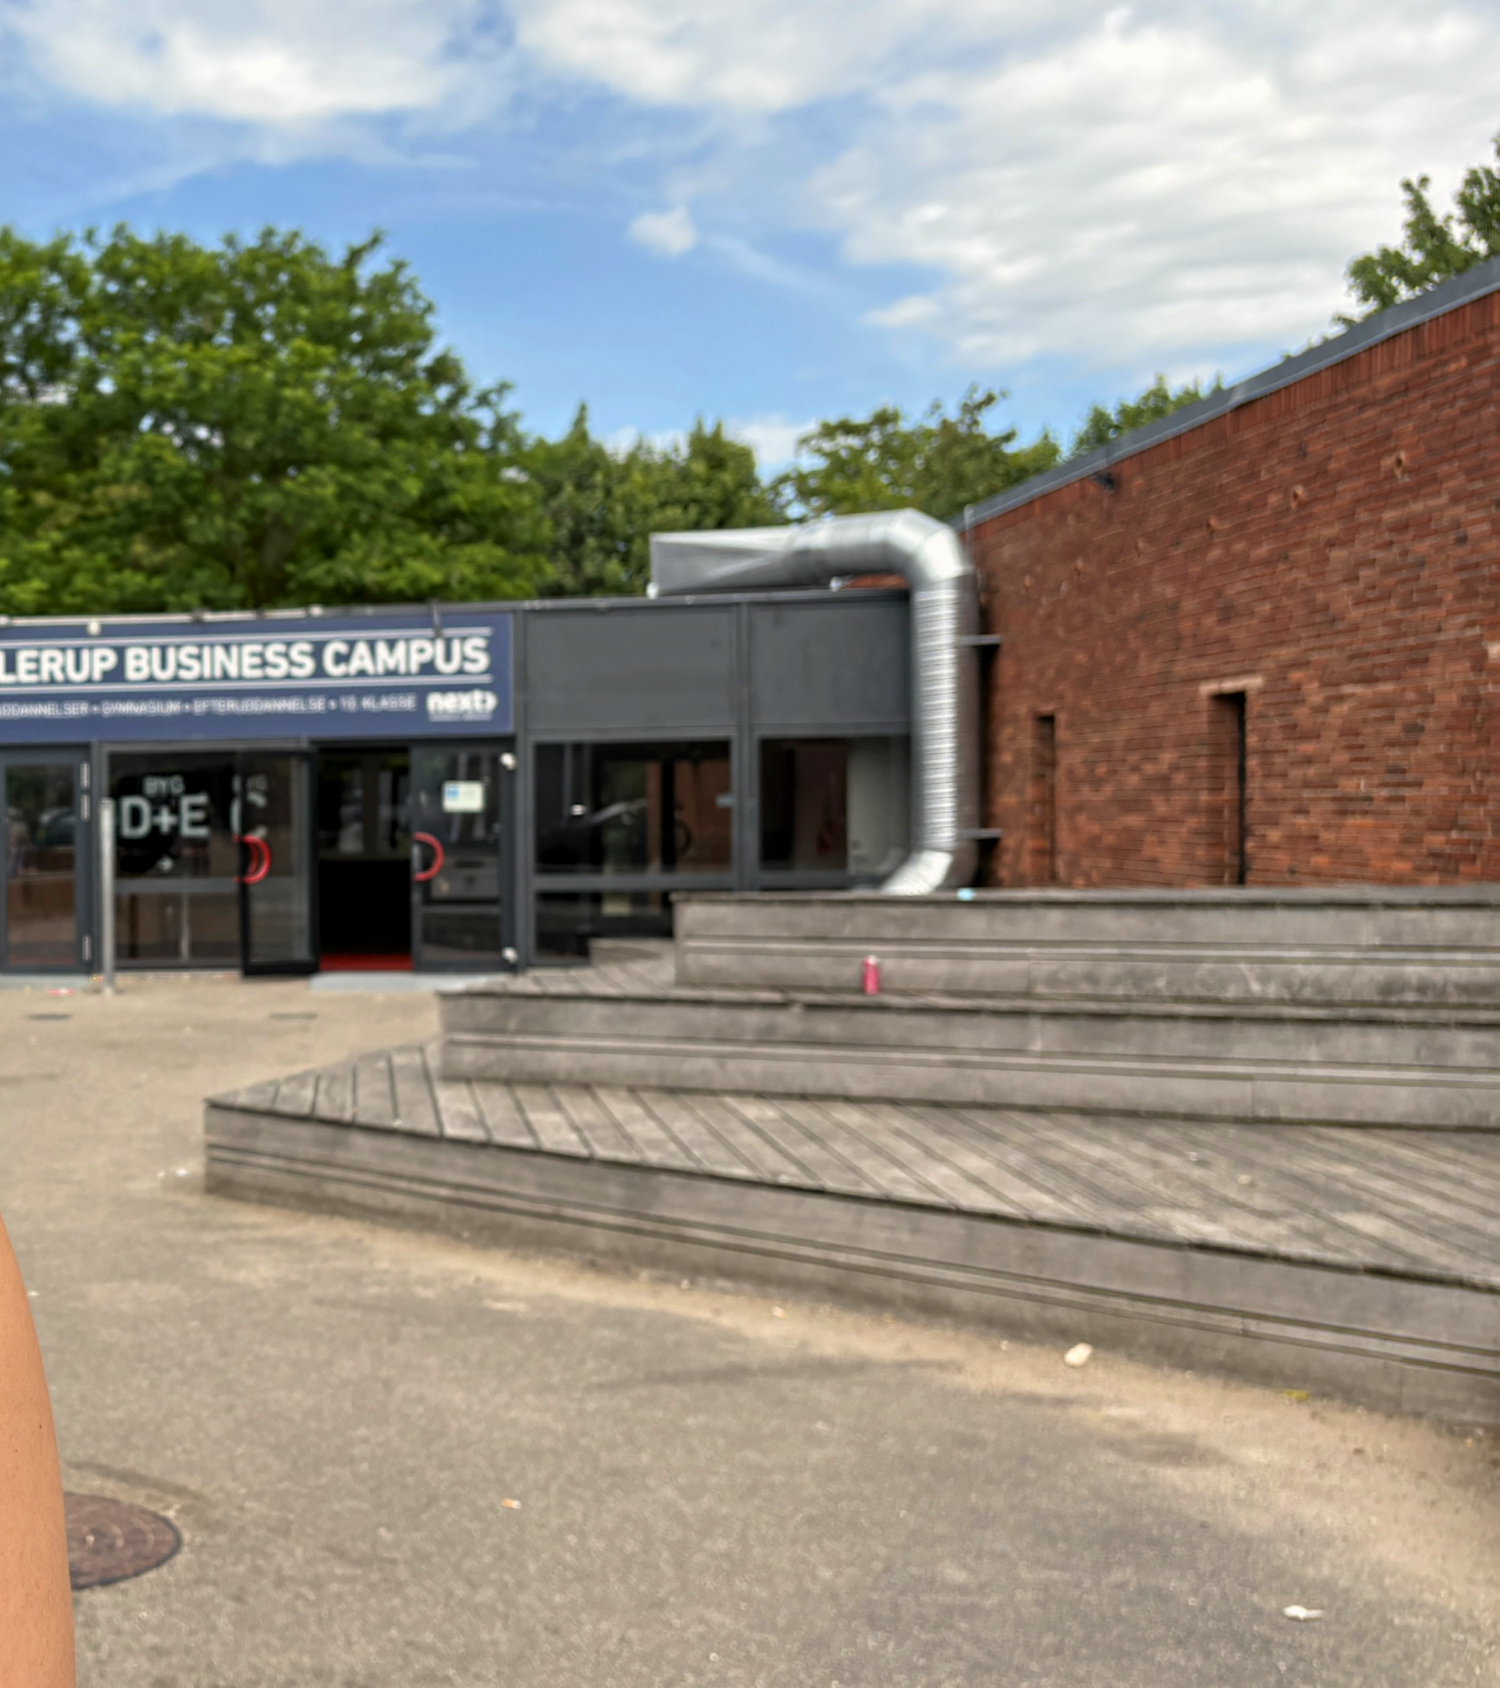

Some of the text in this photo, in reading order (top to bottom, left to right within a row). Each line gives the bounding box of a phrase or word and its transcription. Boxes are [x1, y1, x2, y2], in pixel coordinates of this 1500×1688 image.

[124, 641, 316, 682] BUSINESS
[322, 636, 491, 678] CAMPUS
[101, 700, 181, 716] GYMNASIUM
[362, 695, 416, 711] KLASSE
[143, 775, 185, 796] BYG
[119, 794, 210, 838] D+E
